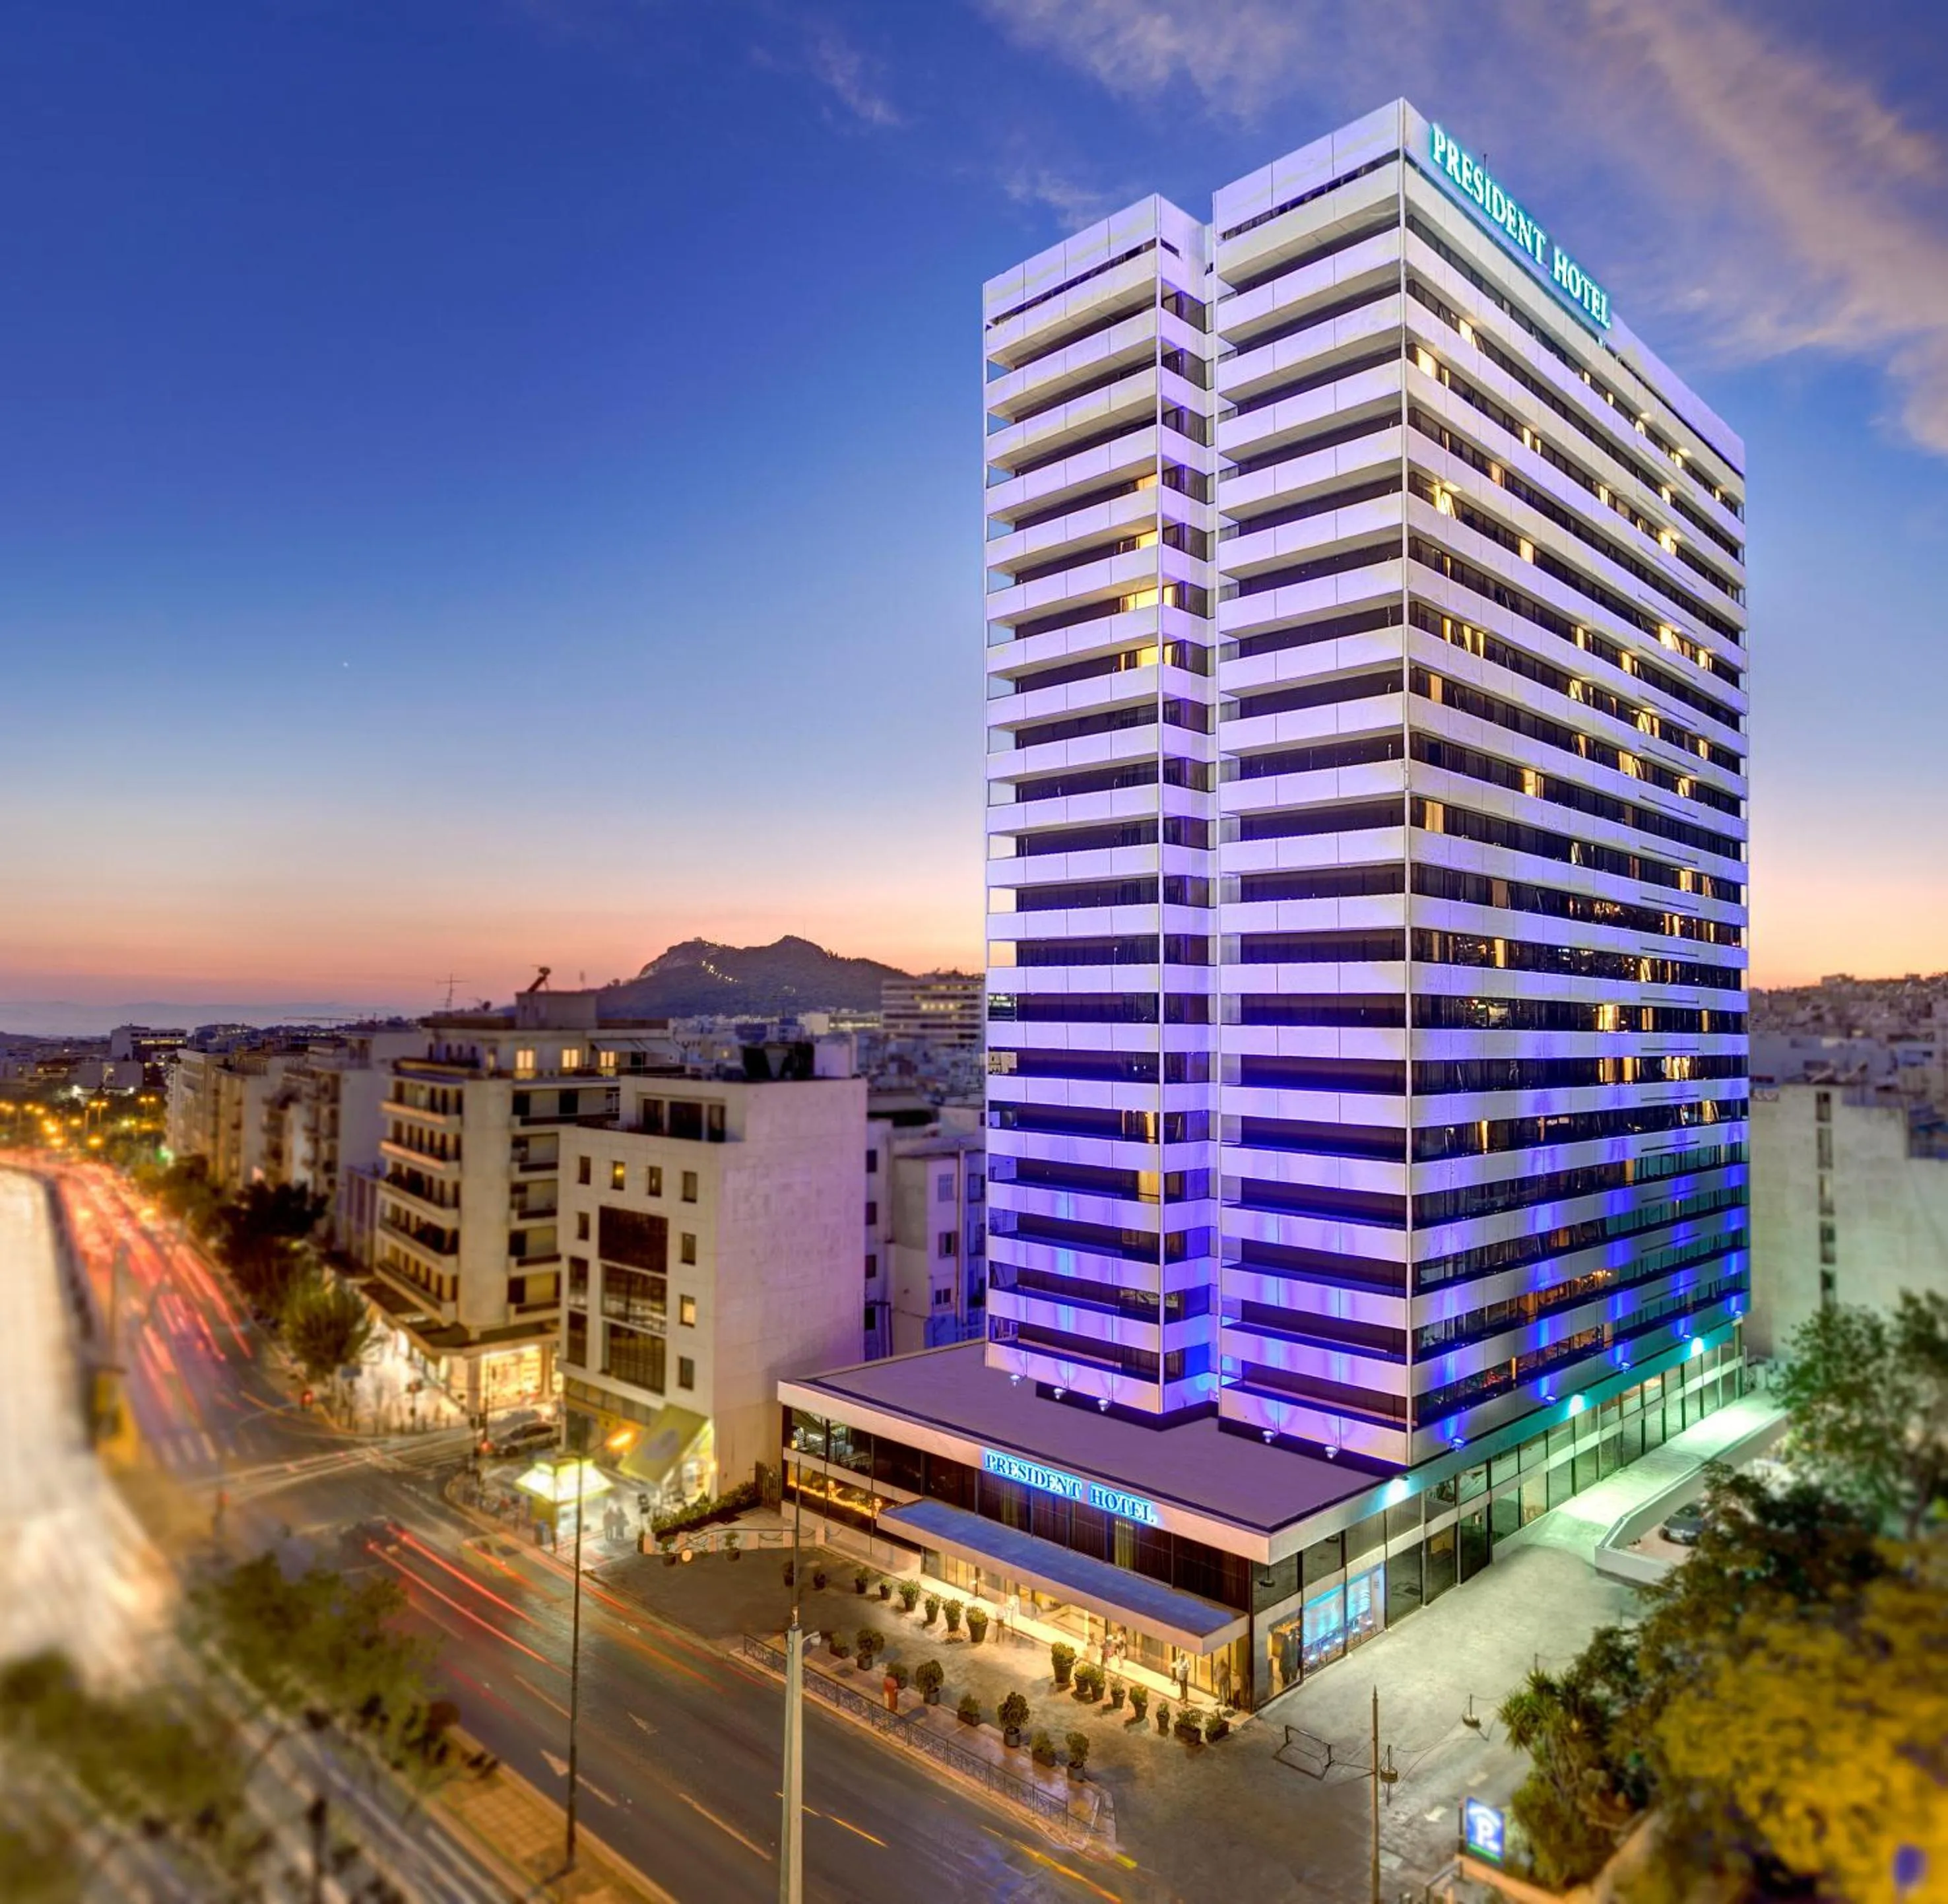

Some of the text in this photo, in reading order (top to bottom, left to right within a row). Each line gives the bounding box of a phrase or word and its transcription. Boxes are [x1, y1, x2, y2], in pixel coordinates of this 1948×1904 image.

[1432, 123, 1611, 330] PRESIDENT HOTEL
[985, 1453, 1155, 1523] PRESIDENT HOTEL
[1475, 1815, 1495, 1847] P
